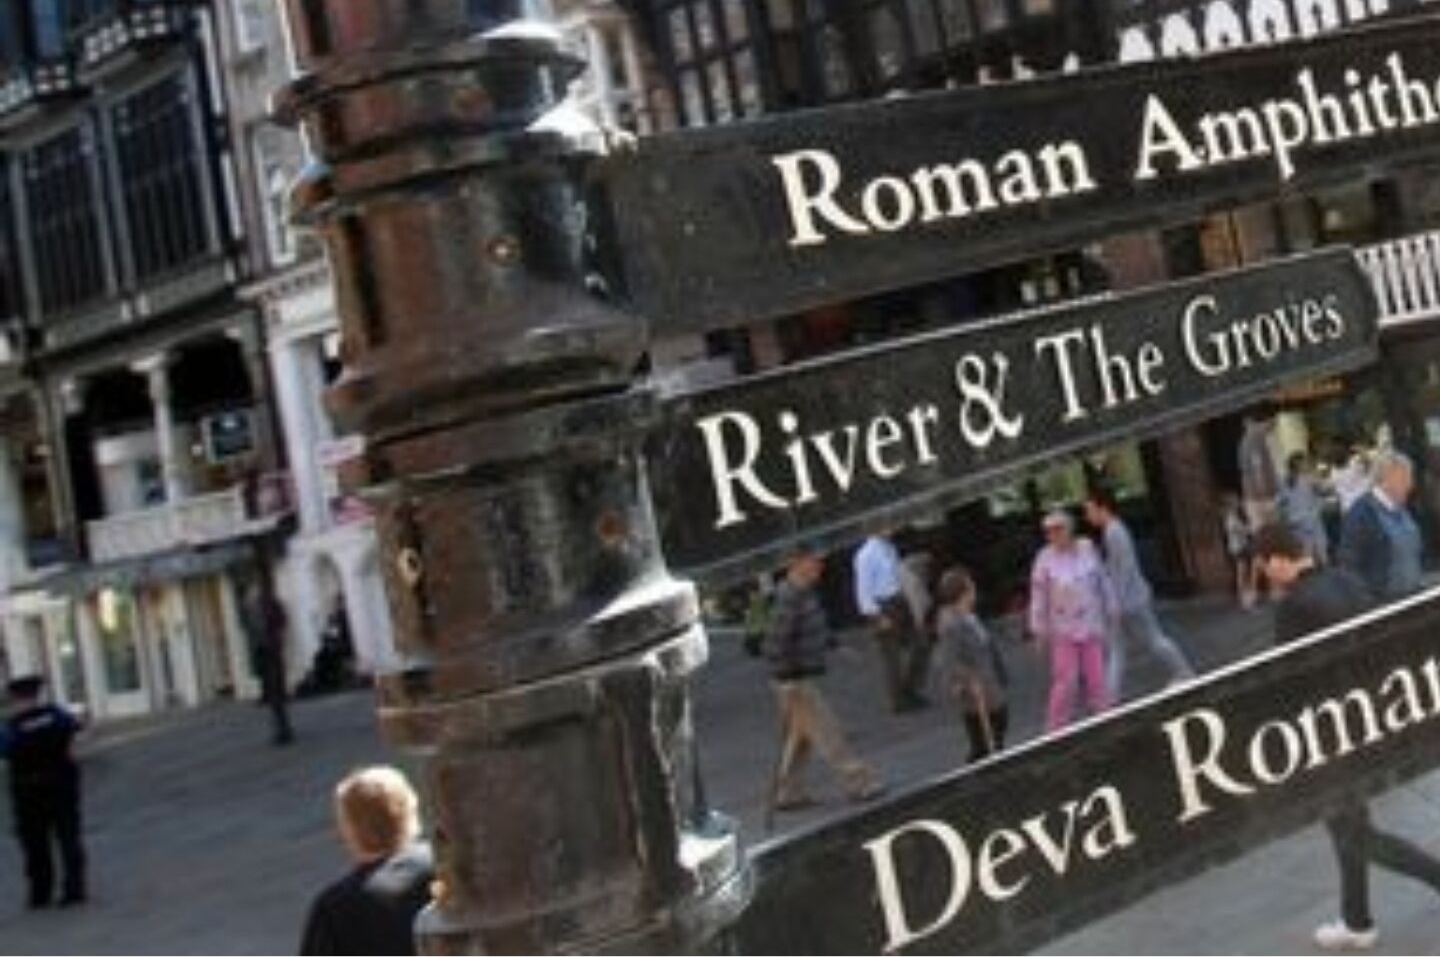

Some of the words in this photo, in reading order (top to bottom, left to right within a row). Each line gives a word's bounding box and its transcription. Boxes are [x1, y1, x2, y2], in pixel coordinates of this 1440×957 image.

[772, 141, 1096, 246] Roman
[697, 405, 938, 528] River
[957, 353, 1023, 447] &
[1039, 326, 1163, 421] The
[1183, 297, 1344, 376] Groves
[863, 786, 1135, 953] Deva
